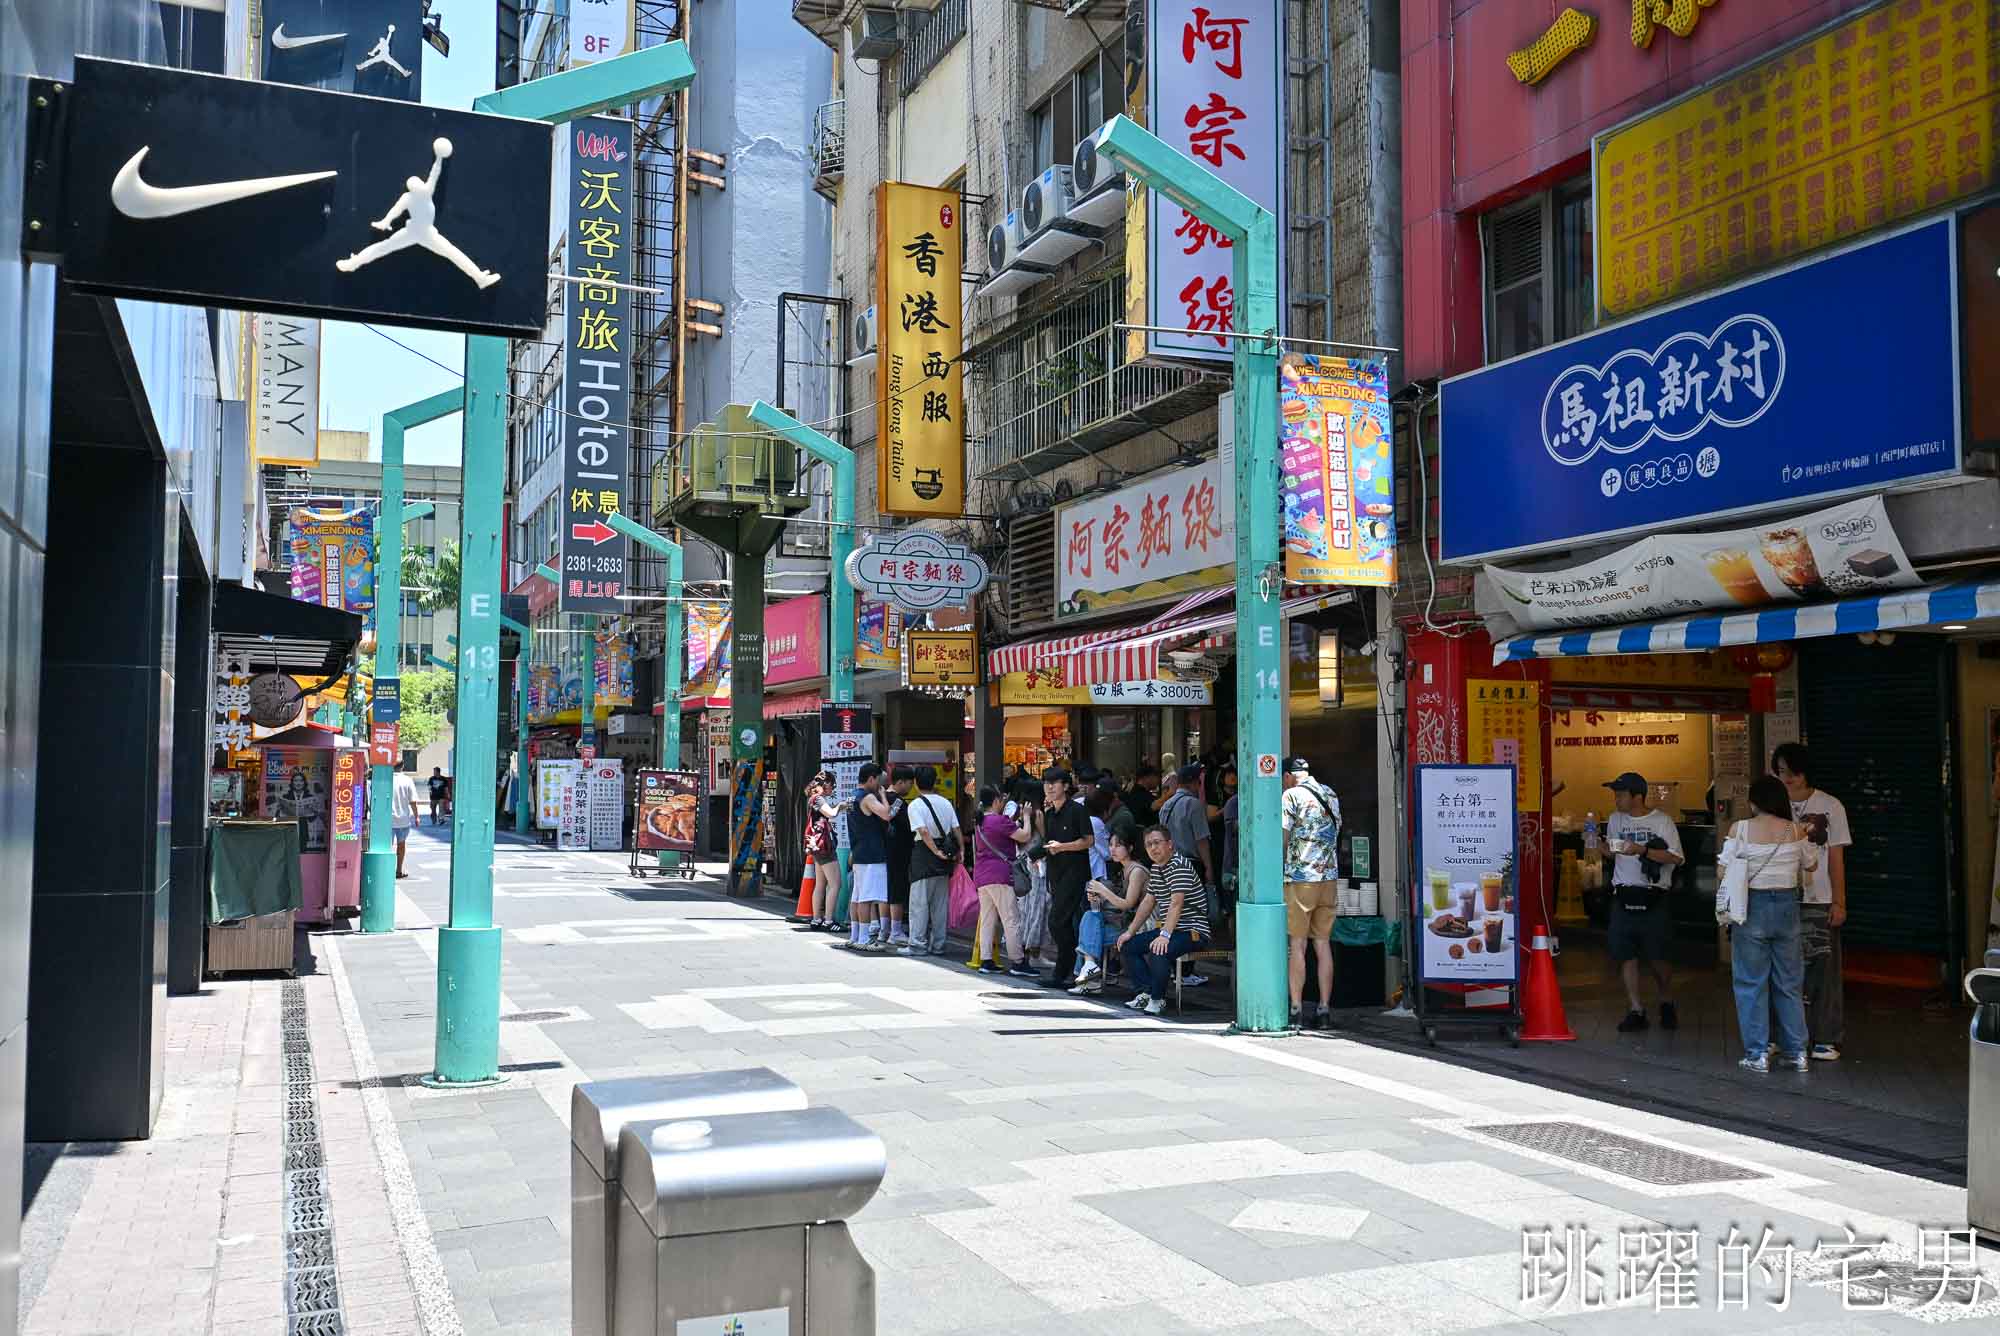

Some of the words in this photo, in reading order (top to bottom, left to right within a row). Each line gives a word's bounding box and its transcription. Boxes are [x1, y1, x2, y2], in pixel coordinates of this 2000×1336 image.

[583, 35, 610, 54] 8F
[576, 168, 624, 353] 沃客商旅
[900, 231, 952, 424] 香港西服
[262, 320, 273, 434] STATIONERY
[276, 320, 305, 436] MANY
[889, 354, 904, 393] Hong
[1295, 365, 1355, 380] WELCOME
[1357, 371, 1375, 384] TO
[1295, 382, 1377, 404] XIMENDING
[1553, 327, 1771, 449] 馬祖新村
[576, 358, 621, 481] Hotel
[889, 396, 904, 435] Kong
[891, 439, 905, 483] Tailor
[1604, 472, 1618, 494] 中
[570, 487, 621, 515] 休息
[302, 525, 365, 536] XIMENDING
[1066, 475, 1223, 579] 阿宗麵線
[566, 555, 623, 574] 2381-2633
[879, 558, 966, 584] 阿宗麵線
[470, 593, 491, 618] E
[1593, 590, 1632, 604] Oolong
[1258, 624, 1274, 646] E
[464, 645, 496, 670] 13
[1255, 668, 1280, 689] 14
[1436, 792, 1497, 808] 全台第一
[1448, 835, 1486, 844] Taiwan
[1457, 846, 1478, 854] Best
[1444, 856, 1493, 865] Souvenirs
